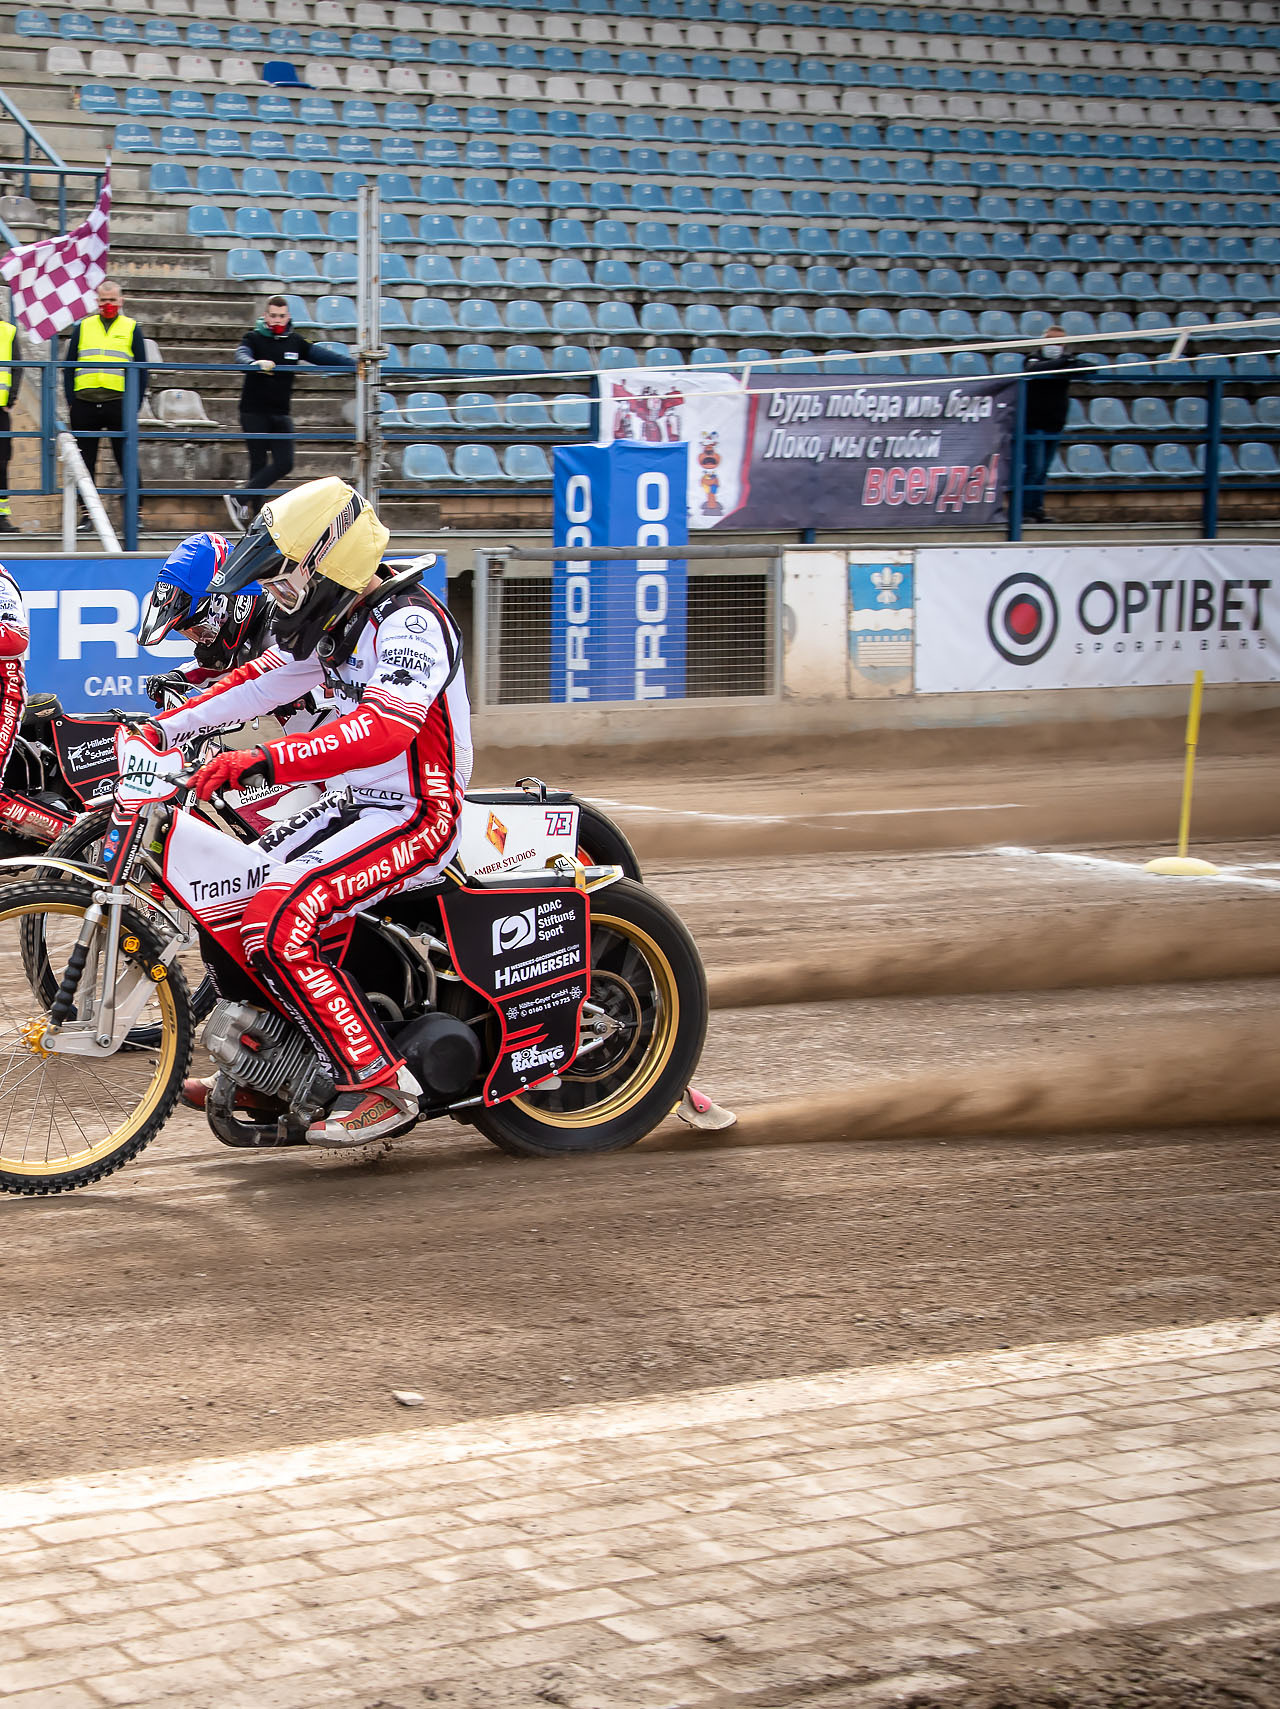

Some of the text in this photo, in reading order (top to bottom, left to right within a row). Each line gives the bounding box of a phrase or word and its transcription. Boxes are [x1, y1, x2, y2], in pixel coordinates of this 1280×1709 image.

[826, 388, 903, 423] победа
[944, 388, 994, 423] беда
[764, 428, 826, 463] Локо,
[828, 437, 866, 458] мы
[883, 429, 943, 458] тобой
[861, 453, 1001, 513] всегда!
[565, 474, 593, 703] TRODO
[634, 471, 670, 700] TRODO
[1077, 579, 1273, 636] OPTIBET
[1074, 640, 1181, 654] SPORTA
[84, 675, 133, 697] CAR
[270, 712, 374, 765] Trans MF
[424, 763, 451, 798] MF
[544, 811, 574, 836] 73
[331, 859, 392, 900] Trans
[391, 835, 420, 872] MF
[502, 848, 537, 868] STUDIOS
[189, 863, 271, 902] Trans MF
[297, 884, 328, 924] MF
[537, 898, 562, 916] ADAC
[538, 909, 576, 929] Stiftung
[538, 924, 564, 942] Sport
[494, 950, 580, 989] HAUMERSEN
[296, 966, 372, 1062] Trans MF
[528, 1006, 543, 1015] 0160
[544, 1002, 552, 1010] 18
[511, 1048, 565, 1073] RACING
